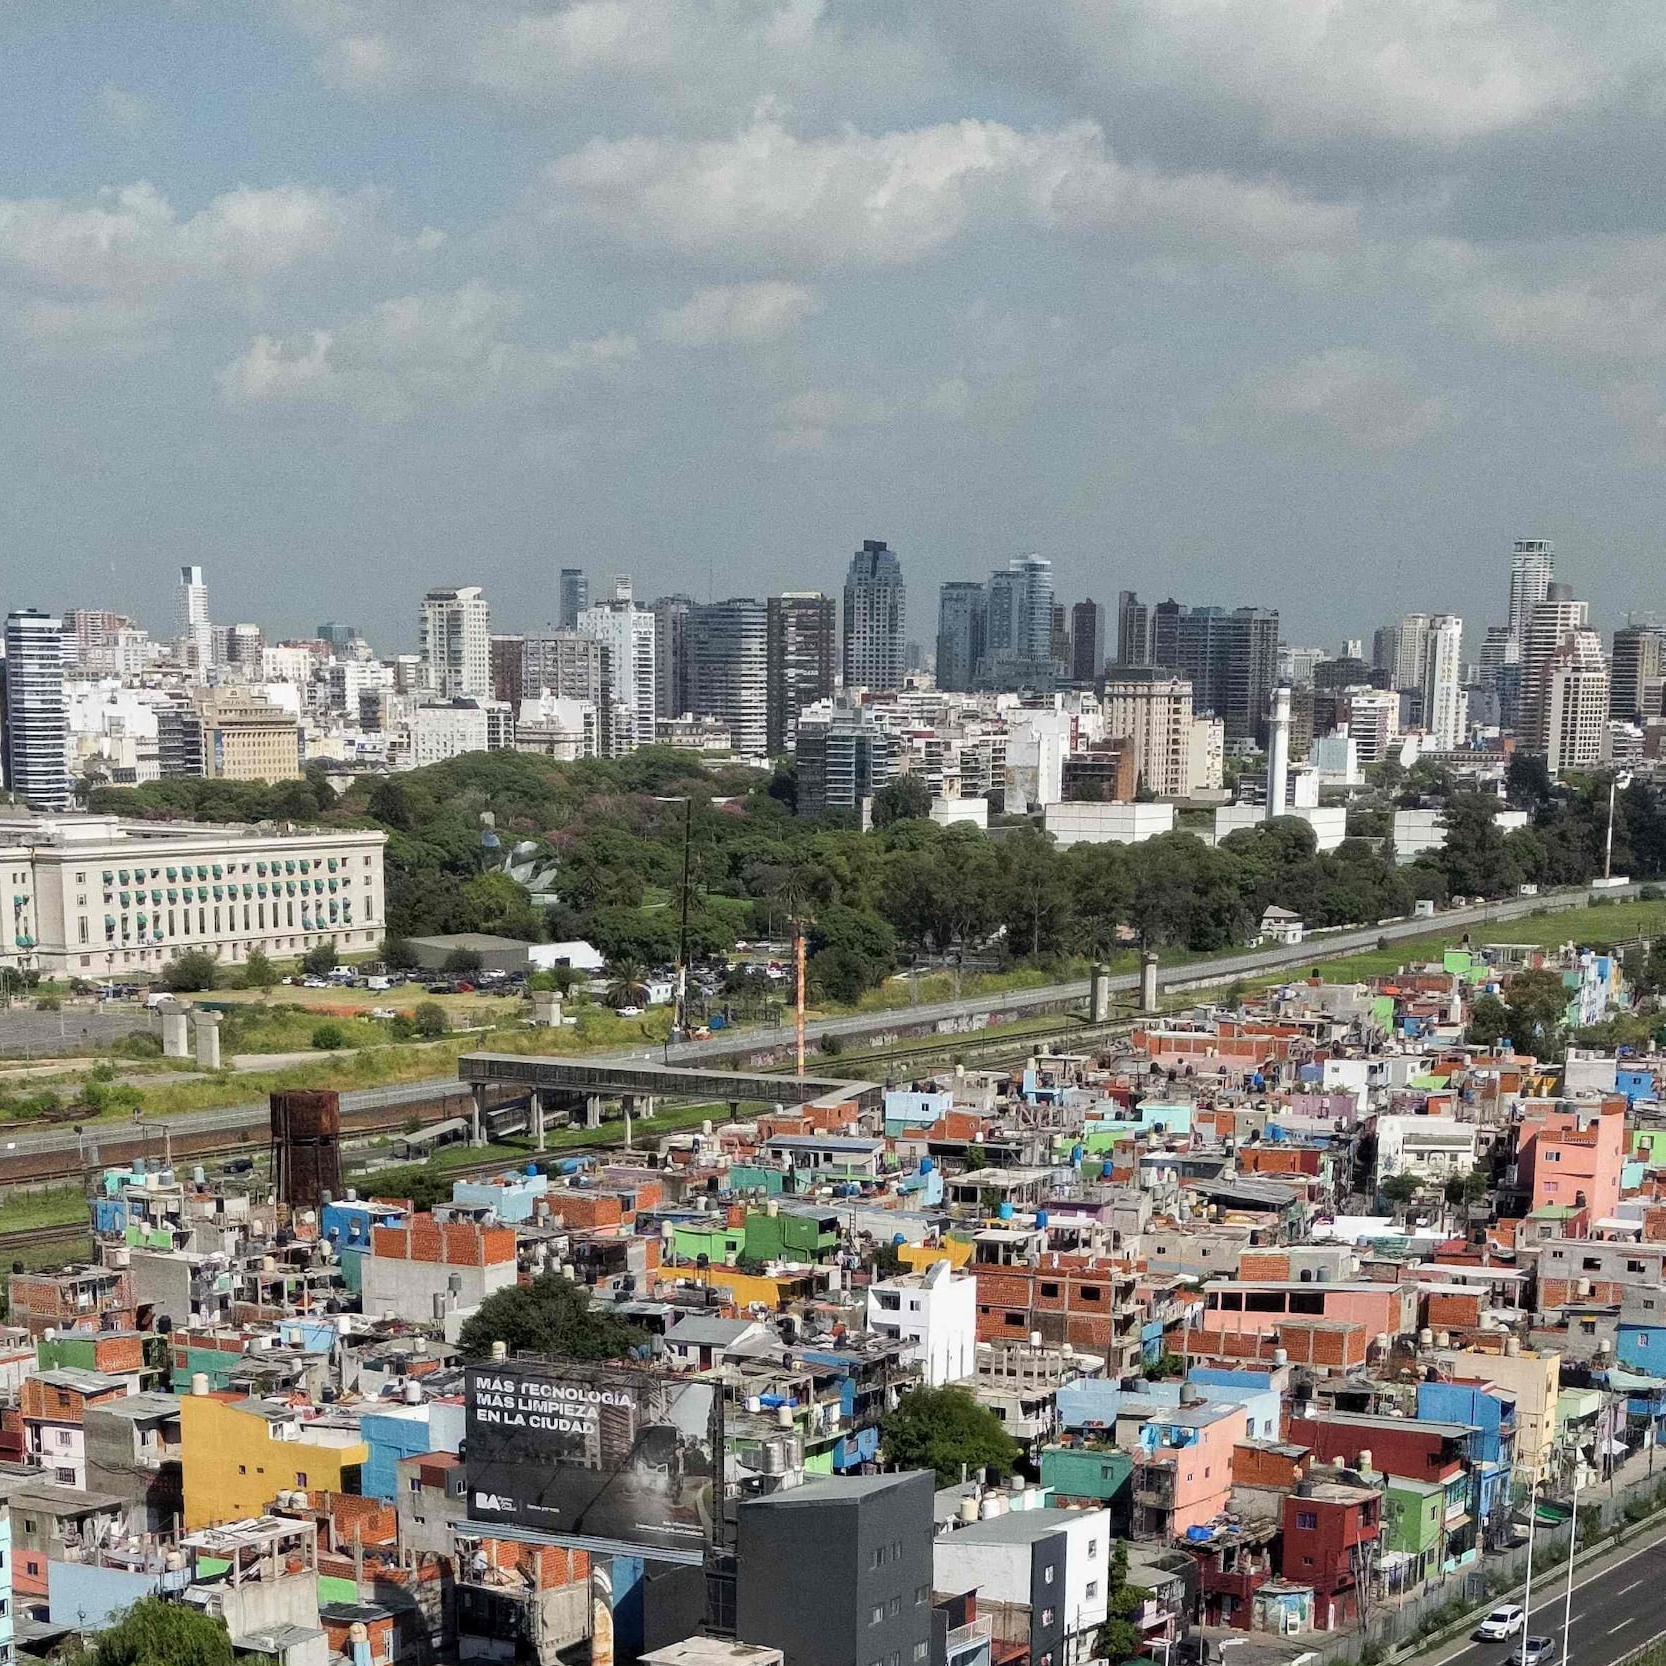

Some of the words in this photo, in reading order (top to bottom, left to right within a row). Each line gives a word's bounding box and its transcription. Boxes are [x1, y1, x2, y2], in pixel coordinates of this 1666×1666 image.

[476, 1375, 515, 1393] MÁS
[521, 1382, 637, 1410] TECNOLOGÍA,
[476, 1391, 515, 1409] MÁS
[518, 1398, 600, 1420] LIMPIEZA
[476, 1408, 501, 1423] EN
[503, 1412, 526, 1427] LA
[529, 1415, 596, 1434] CIUDAD
